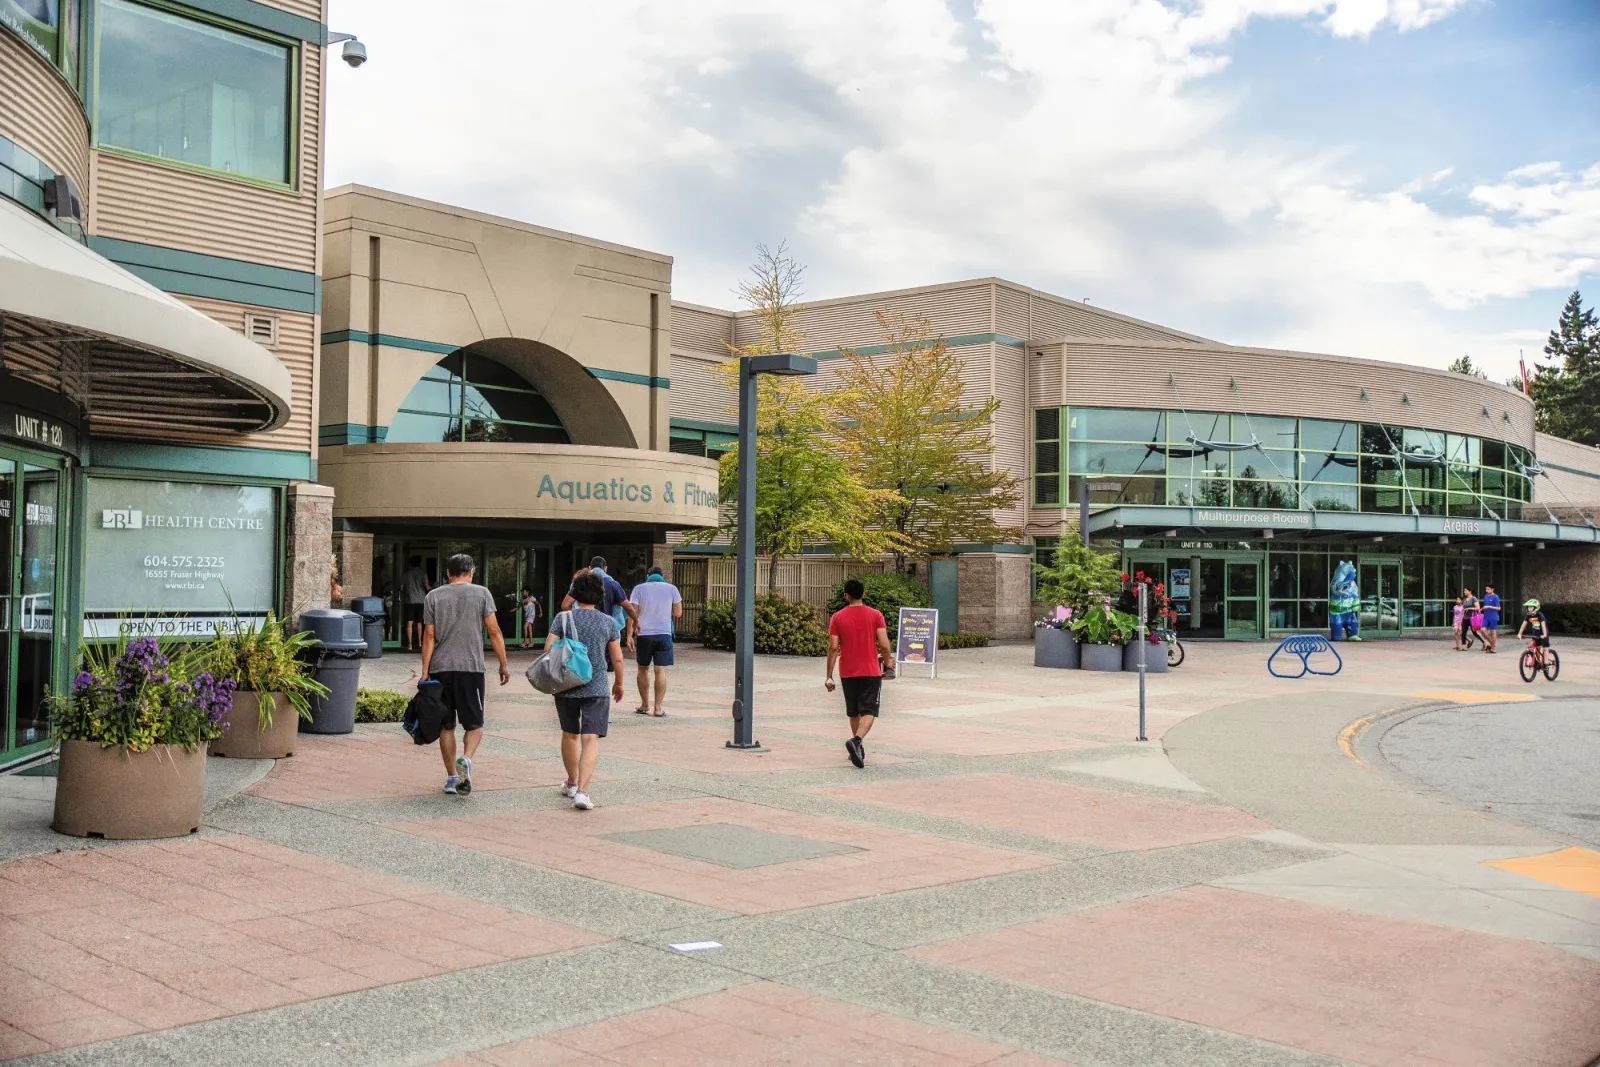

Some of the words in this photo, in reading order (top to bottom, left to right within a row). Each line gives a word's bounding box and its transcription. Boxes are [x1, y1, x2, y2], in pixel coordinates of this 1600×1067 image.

[15, 413, 39, 439] UNIT
[42, 420, 48, 442] #
[51, 424, 63, 447] 120
[536, 474, 653, 504] Aquatics
[663, 480, 675, 504] &
[145, 515, 204, 528] HEALTH
[208, 517, 264, 530] CENTRE
[1198, 511, 1270, 524] Multipurpose
[1272, 512, 1309, 524] Rooms
[1443, 519, 1480, 533] Arenas
[1180, 541, 1194, 549] UNIT
[144, 554, 225, 568] 604.575.2325
[145, 570, 168, 578] 16555
[170, 570, 193, 579] Fraser
[194, 570, 225, 581] Highway
[165, 582, 205, 590] www.cbi.ca
[119, 622, 154, 633] OPEN
[158, 621, 175, 632] TO
[179, 621, 202, 632] THE
